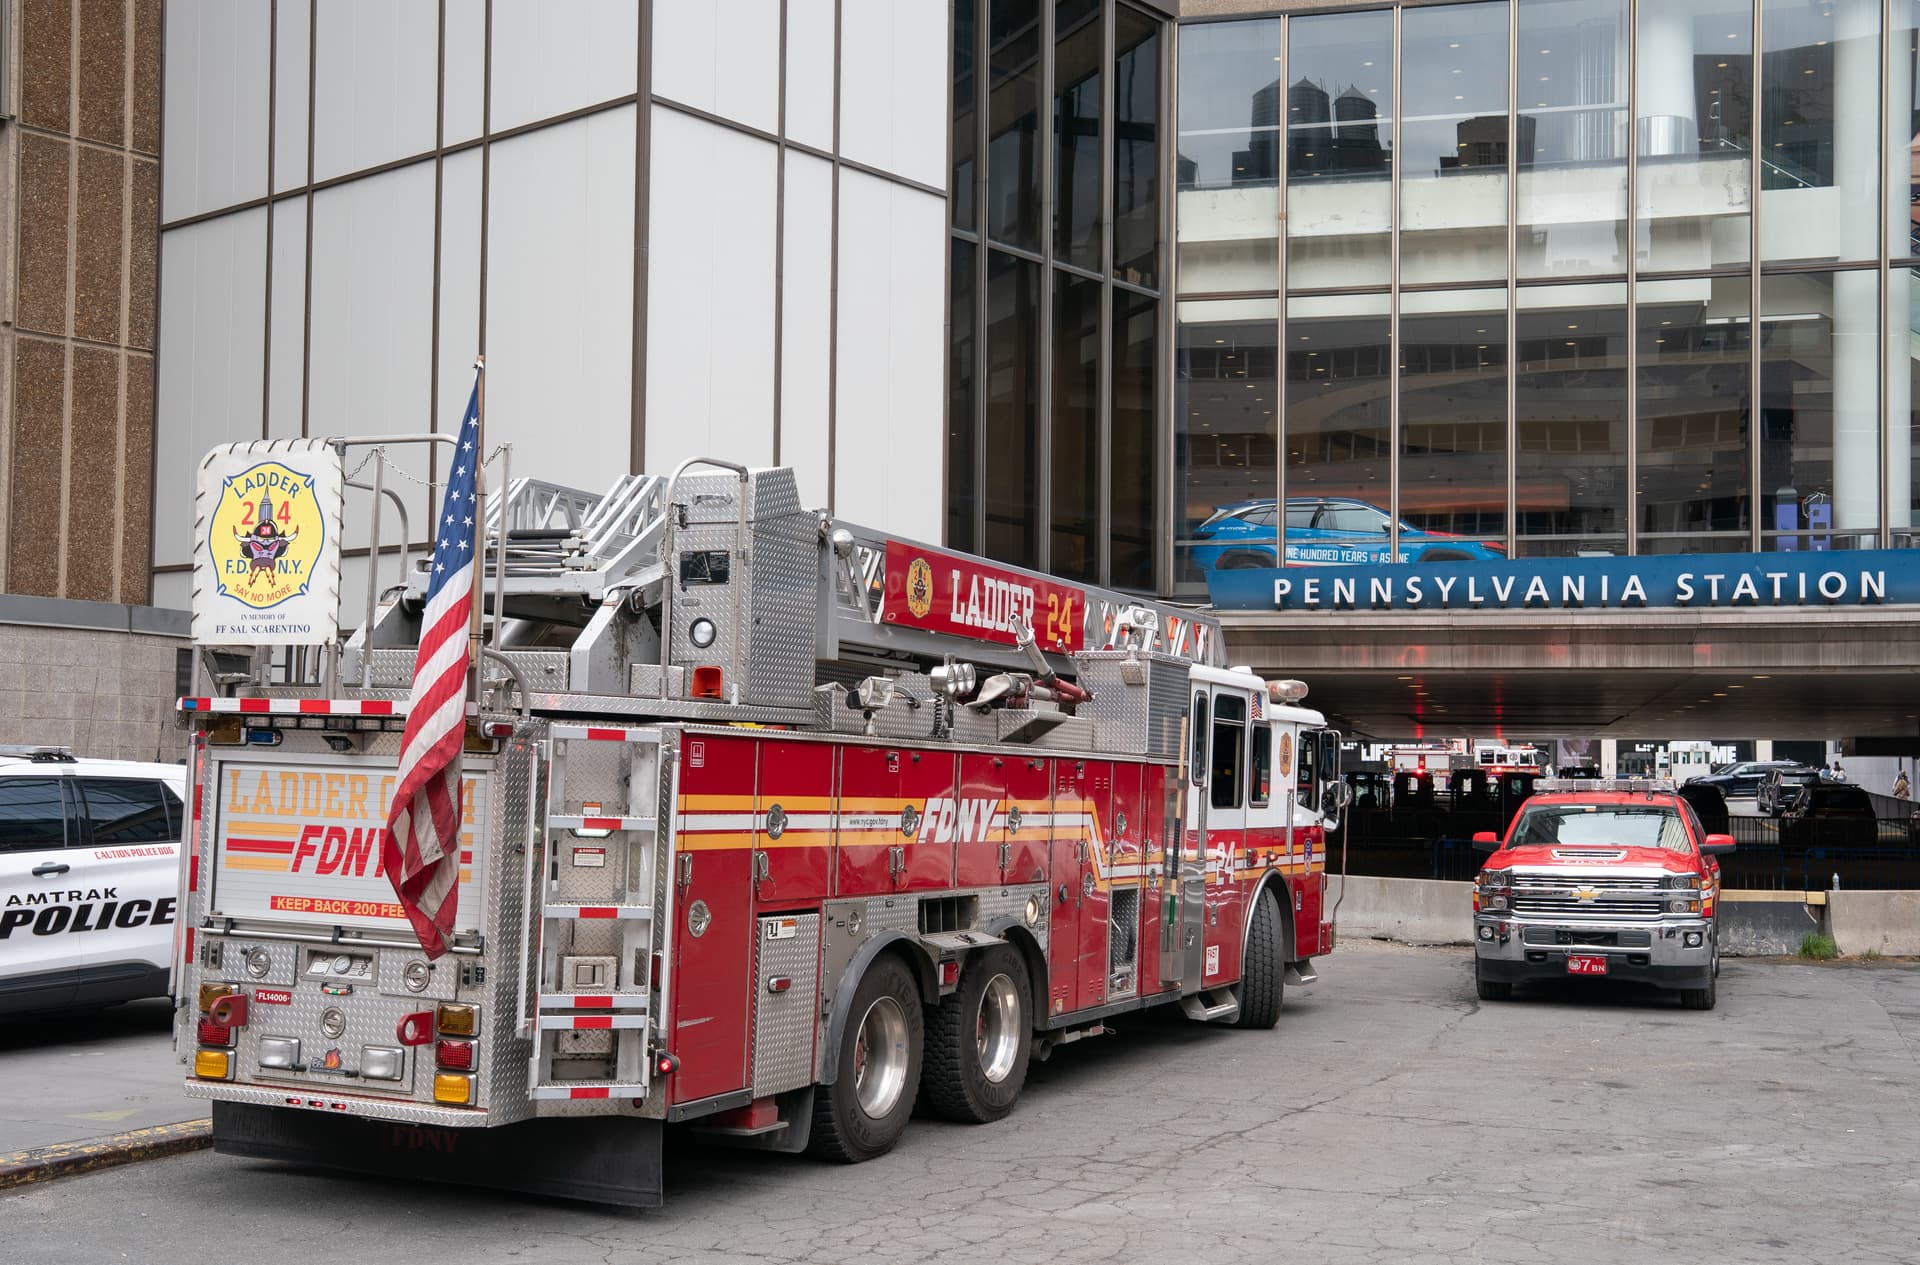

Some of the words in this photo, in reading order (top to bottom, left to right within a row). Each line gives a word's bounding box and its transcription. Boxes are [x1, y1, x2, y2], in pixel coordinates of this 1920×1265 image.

[234, 472, 301, 499] LADDER
[1300, 548, 1339, 561] HUNDRED
[1340, 551, 1368, 562] YEARS
[278, 559, 303, 575] N.Y.
[233, 583, 250, 598] SAY
[250, 592, 264, 602] NO
[266, 583, 292, 602] MORE
[1273, 575, 1648, 604] PENNSYLVANIA
[1676, 570, 1885, 601] STATION
[950, 569, 1035, 634] LADDER
[1047, 593, 1073, 644] 24
[215, 625, 227, 633] FF
[230, 625, 248, 633] SAL
[251, 624, 311, 633] SCARENTINO
[228, 768, 369, 820] LADDER
[918, 797, 998, 844] FDNY
[94, 849, 131, 860] CAUTION
[131, 847, 158, 857] POLICE
[158, 846, 175, 855] DOG
[6, 887, 118, 907] AMTRAK
[276, 897, 311, 911] KEEP
[314, 900, 350, 914] BACK
[353, 903, 377, 916] 200
[0, 897, 176, 939] POLICE
[1581, 959, 1591, 971] 7
[1591, 964, 1605, 972] BN
[258, 992, 288, 1002] FL14006
